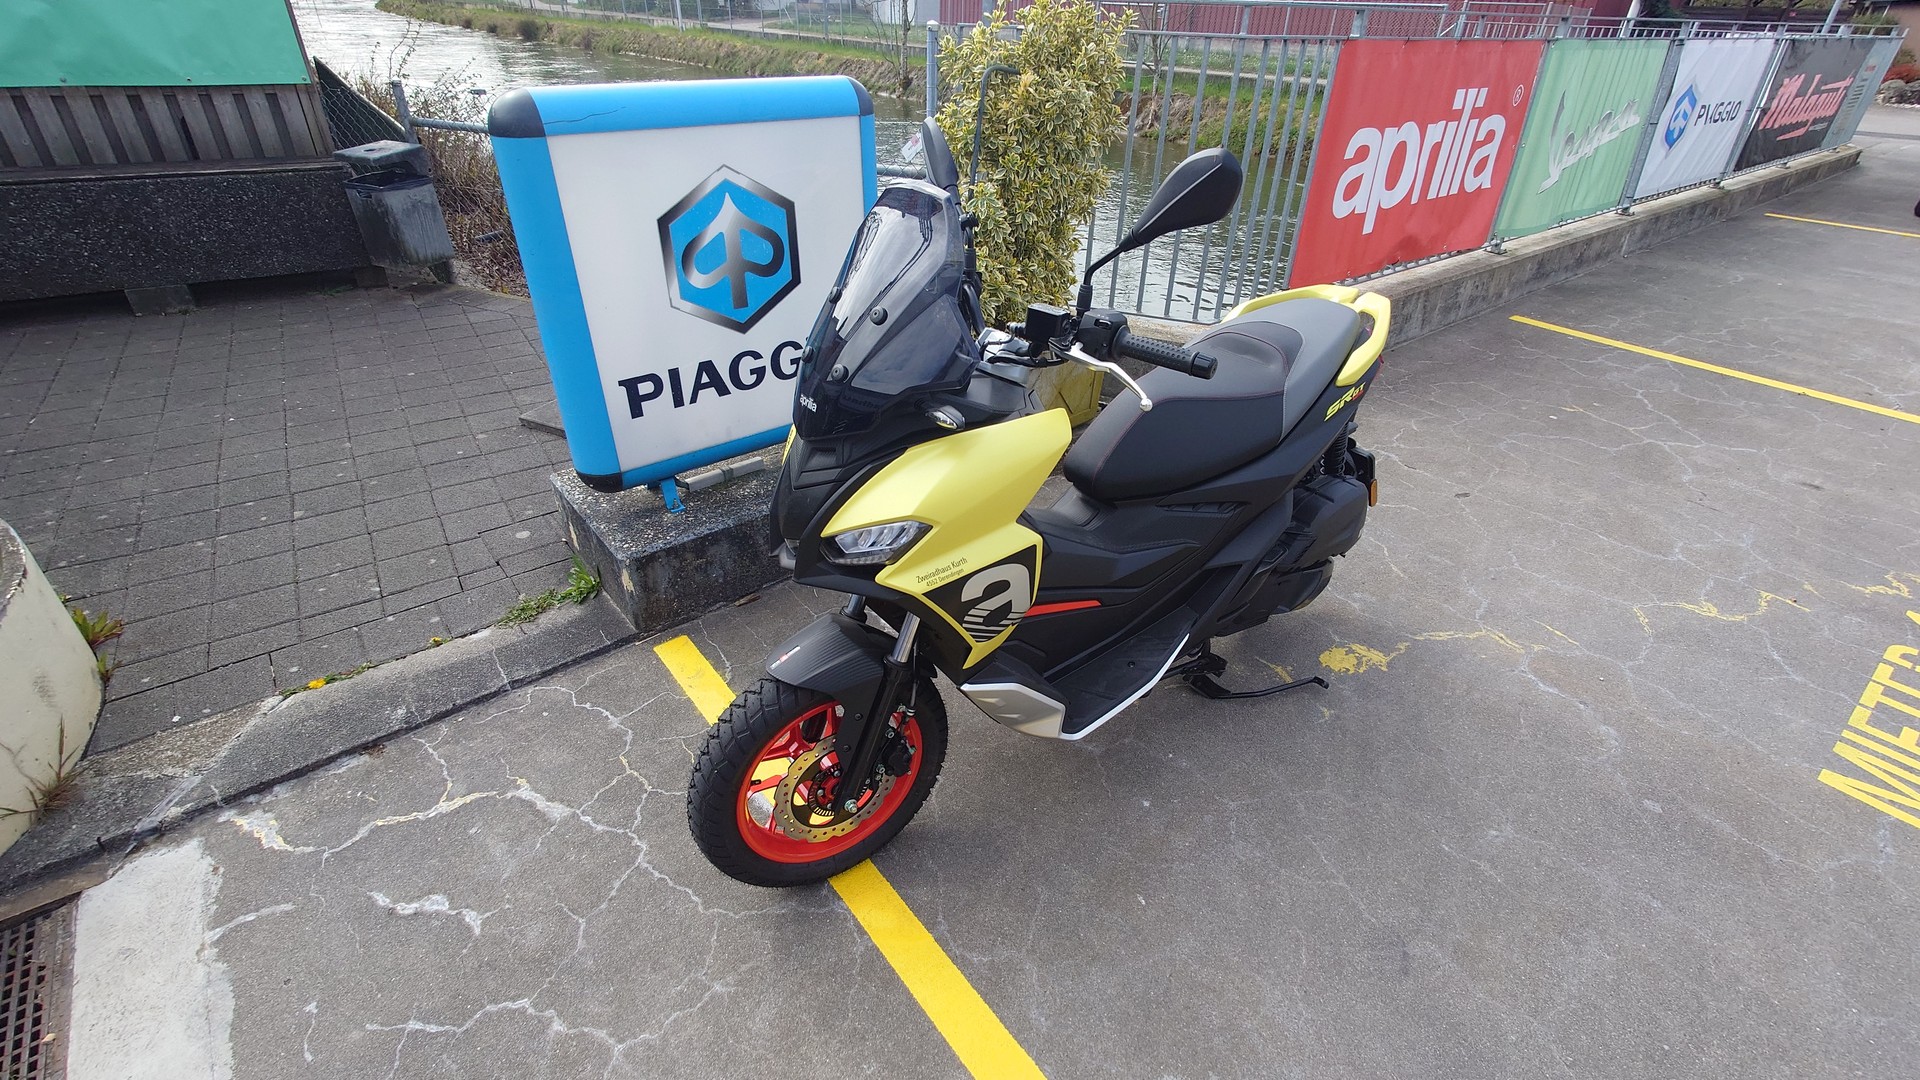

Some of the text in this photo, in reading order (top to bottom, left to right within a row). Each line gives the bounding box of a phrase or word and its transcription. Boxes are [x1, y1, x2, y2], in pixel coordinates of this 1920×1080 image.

[1537, 89, 1640, 194] Vespa
[1332, 87, 1506, 235] aprilia
[800, 394, 817, 412] aprilia
[916, 557, 968, 583] Zweiradhaus Kurth
[926, 578, 938, 587] 4552
